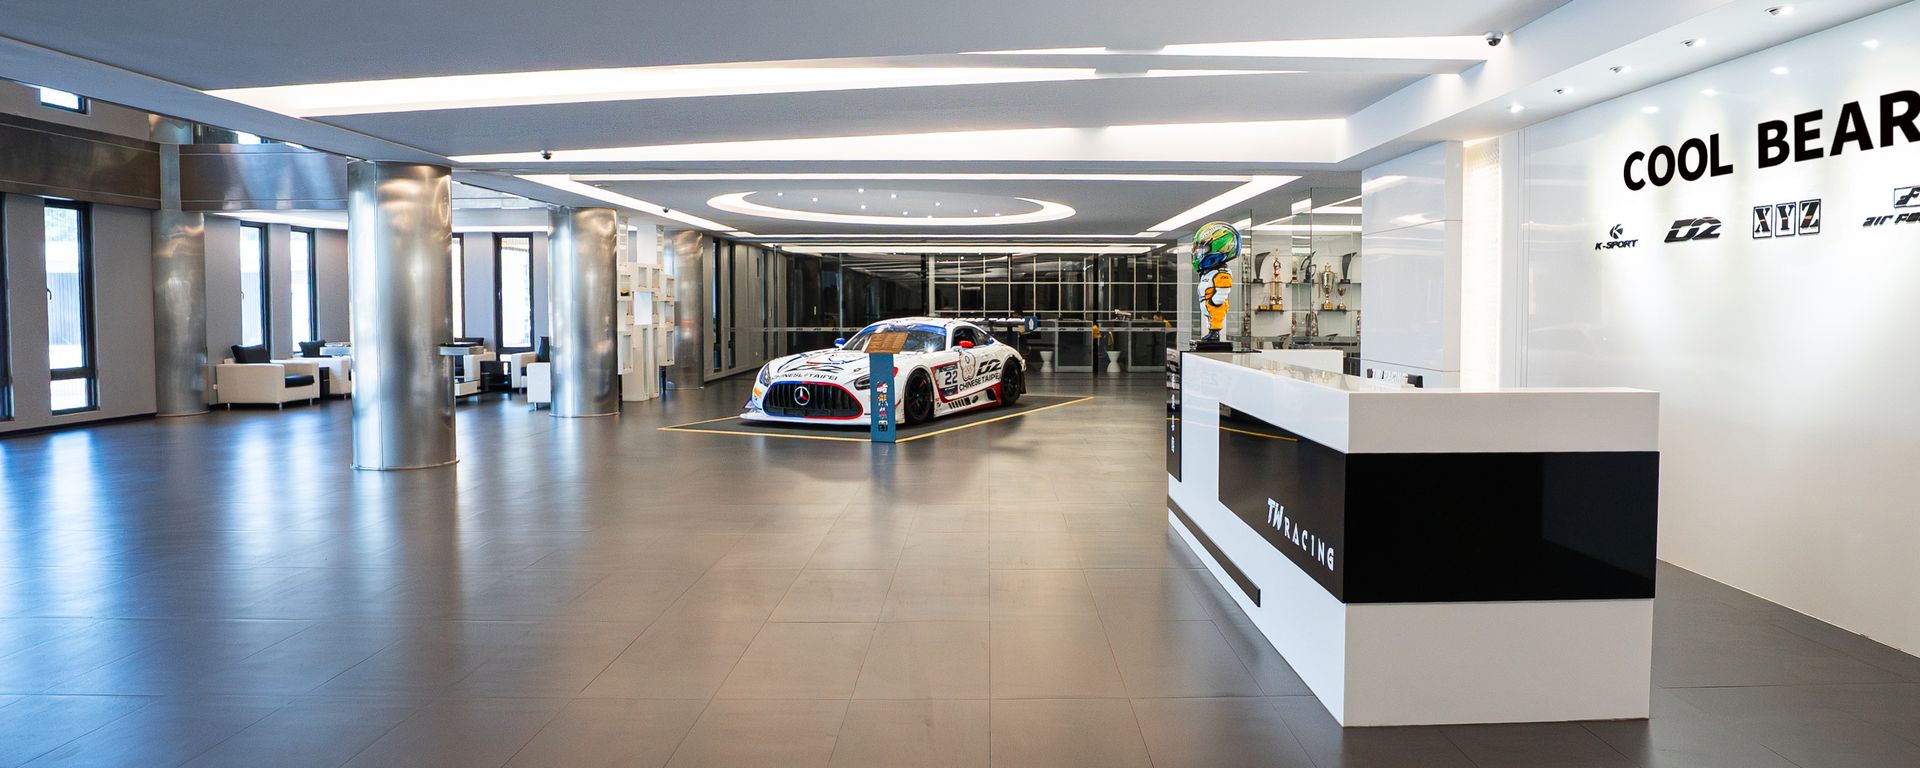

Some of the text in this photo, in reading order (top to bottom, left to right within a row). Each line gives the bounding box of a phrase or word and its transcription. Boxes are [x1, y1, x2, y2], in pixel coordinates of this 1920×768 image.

[1623, 90, 1920, 191] COOL BEAR
[1753, 199, 1821, 237] XYZ
[1863, 214, 1894, 226] air
[1664, 216, 1722, 243] D2
[1595, 239, 1639, 250] K-SPORT
[944, 370, 958, 386] 22
[959, 378, 981, 391] CHINESE
[981, 372, 1003, 383] TAIPE
